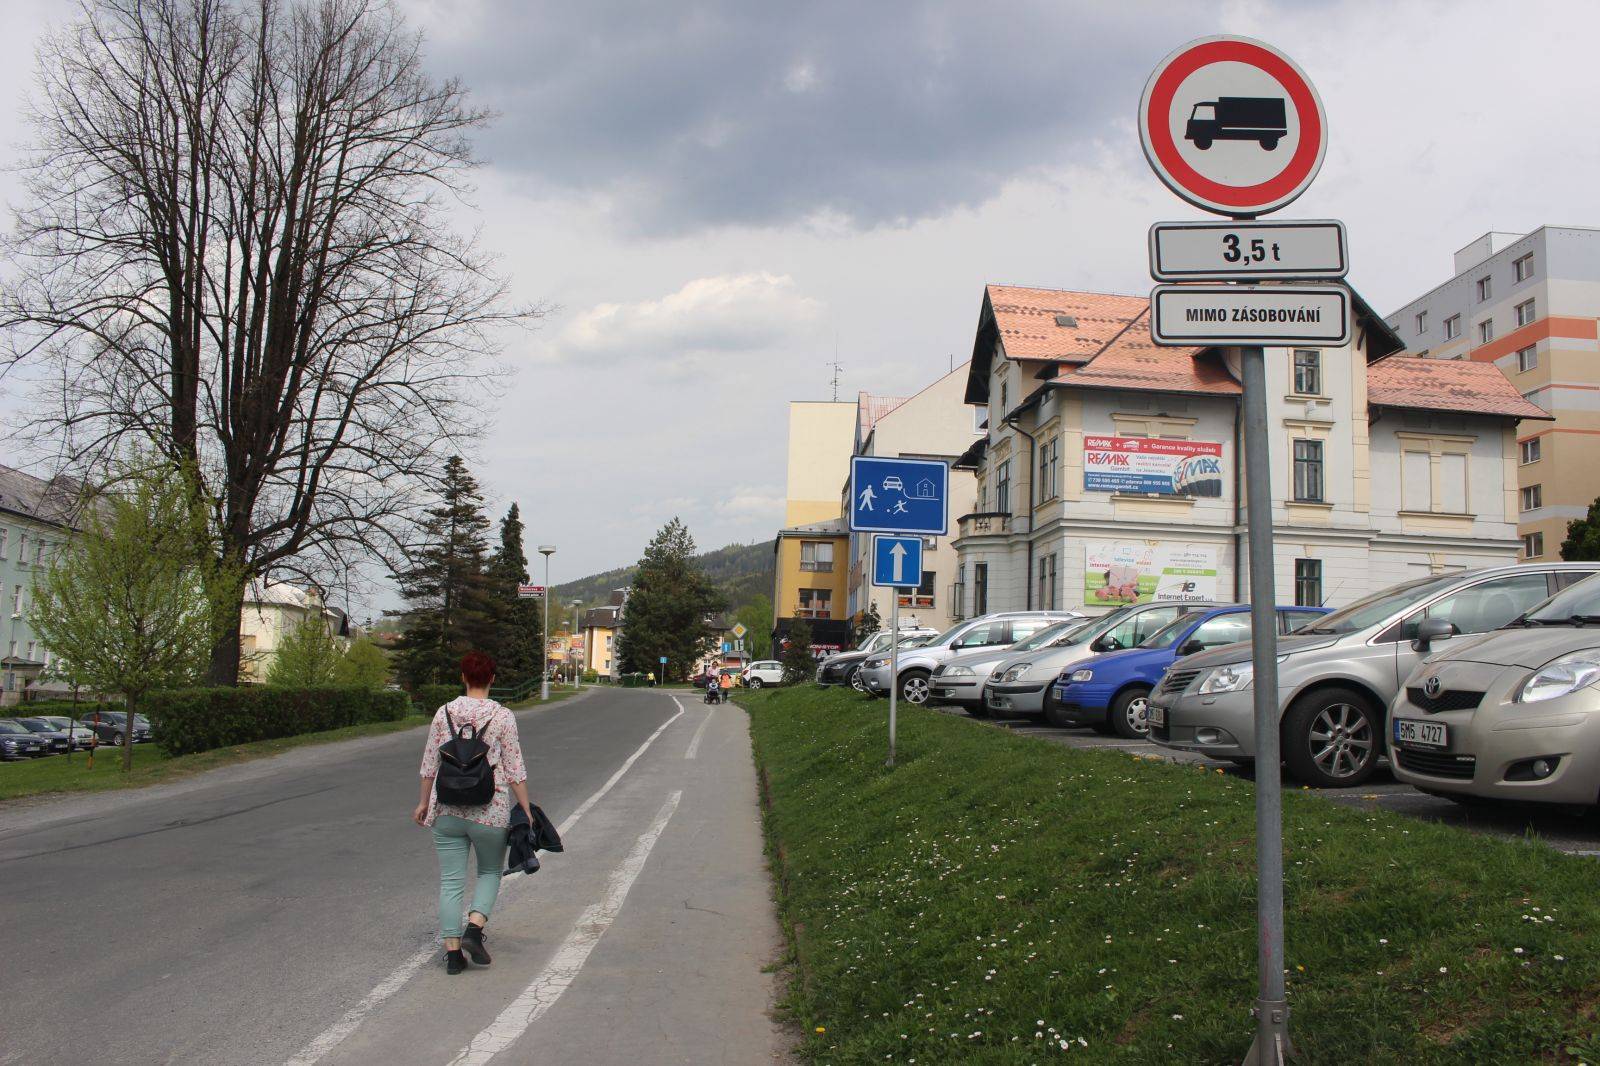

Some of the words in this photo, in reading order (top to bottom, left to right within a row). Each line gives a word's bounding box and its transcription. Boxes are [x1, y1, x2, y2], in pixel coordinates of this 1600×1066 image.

[1223, 233, 1265, 266] 3,5
[1271, 243, 1281, 262] t
[1186, 308, 1227, 322] MIMO
[1231, 305, 1321, 323] ZÁSOBOVÁNÍ
[1087, 439, 1112, 447] RE/MAX
[1151, 443, 1176, 451] Garance
[1177, 445, 1196, 453] kvality
[1087, 452, 1130, 466] RE/MAX
[1421, 725, 1442, 743] 4727
